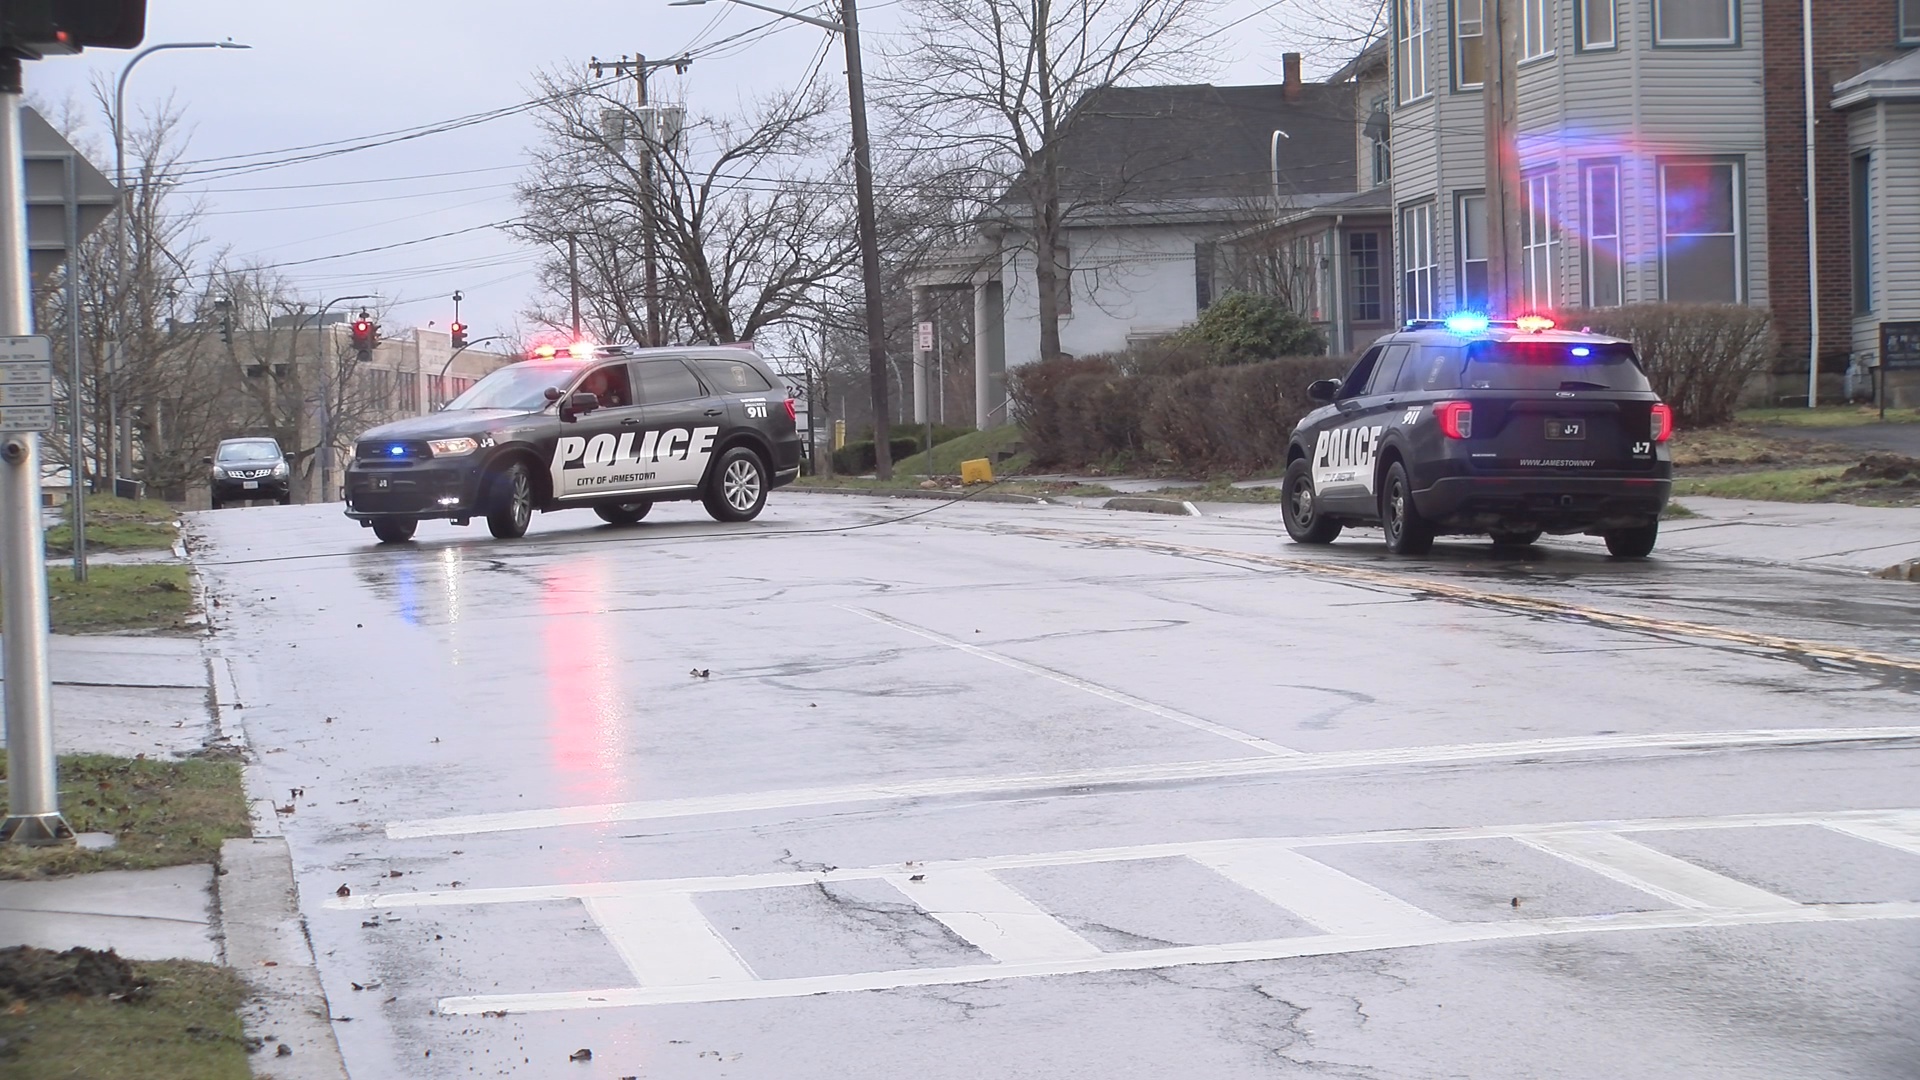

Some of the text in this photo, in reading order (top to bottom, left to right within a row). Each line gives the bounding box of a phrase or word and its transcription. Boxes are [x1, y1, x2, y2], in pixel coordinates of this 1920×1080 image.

[747, 406, 768, 418] 911
[1401, 411, 1420, 424] 911
[1564, 424, 1579, 434] J-7
[480, 437, 495, 448] J-9
[556, 426, 719, 470] POLICE
[1316, 426, 1382, 467] POLICE
[1632, 441, 1650, 454] J-7
[577, 472, 656, 486] CITY OF JAMESTOWN
